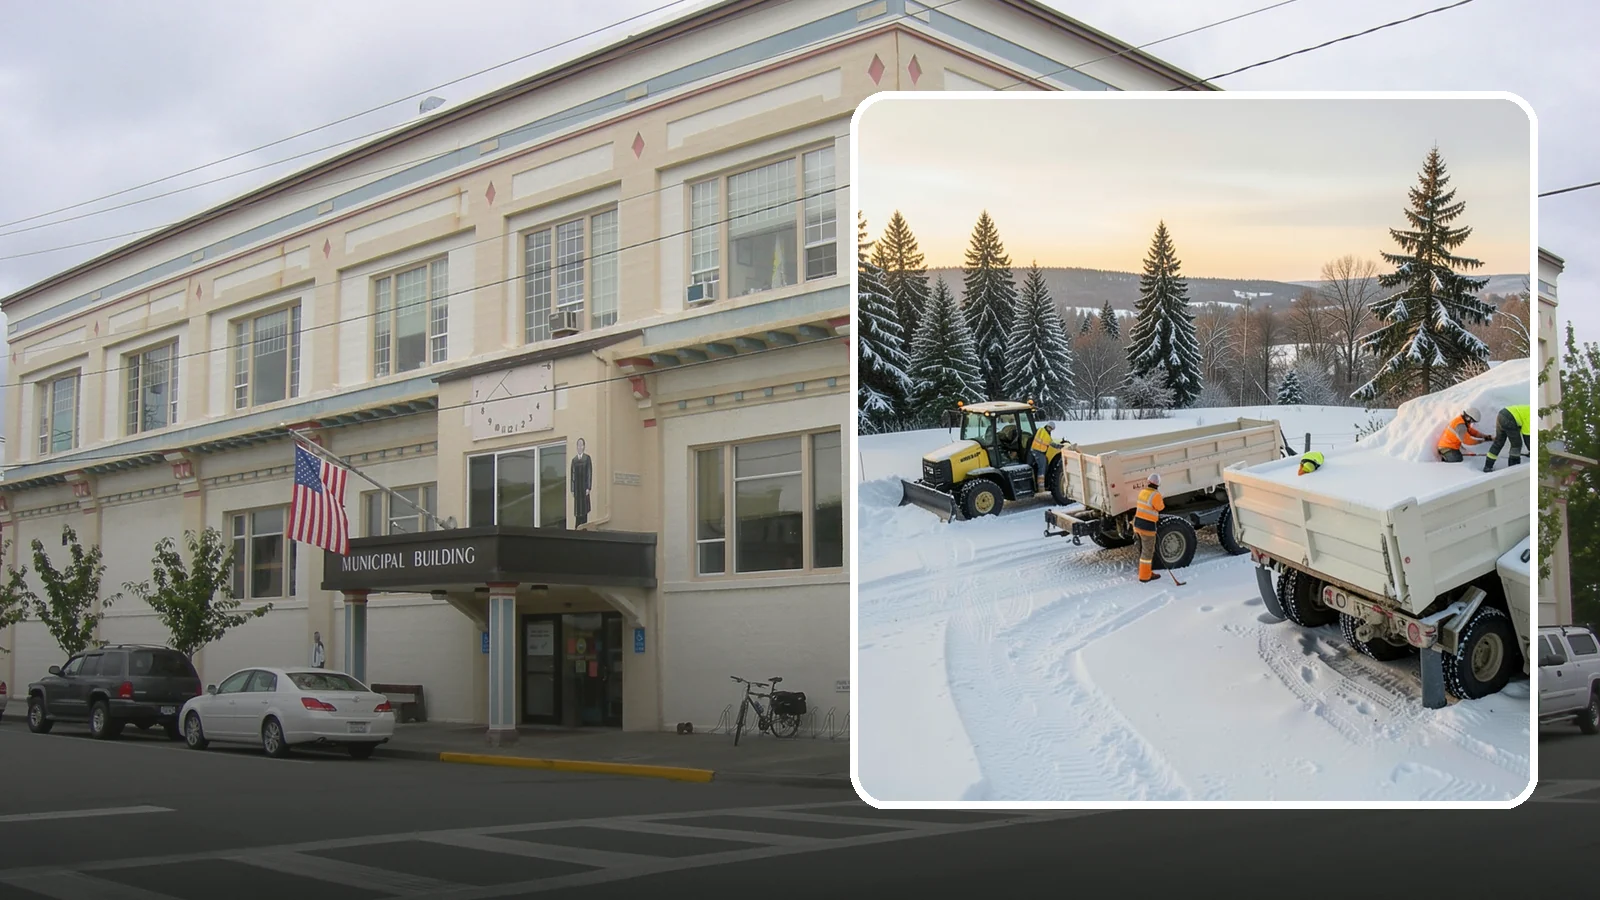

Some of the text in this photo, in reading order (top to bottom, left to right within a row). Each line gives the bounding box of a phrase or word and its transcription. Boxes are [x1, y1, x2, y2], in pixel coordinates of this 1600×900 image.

[546, 361, 552, 371] 6
[475, 389, 479, 398] 7
[480, 406, 485, 415] 8
[536, 402, 540, 410] 4
[488, 417, 492, 426] 9
[529, 413, 533, 422] 3
[494, 423, 500, 432] 10
[521, 420, 526, 429] 2
[501, 425, 506, 434] 11
[507, 425, 514, 434] 12
[341, 546, 476, 572] MUNICIPAL BUILDING
